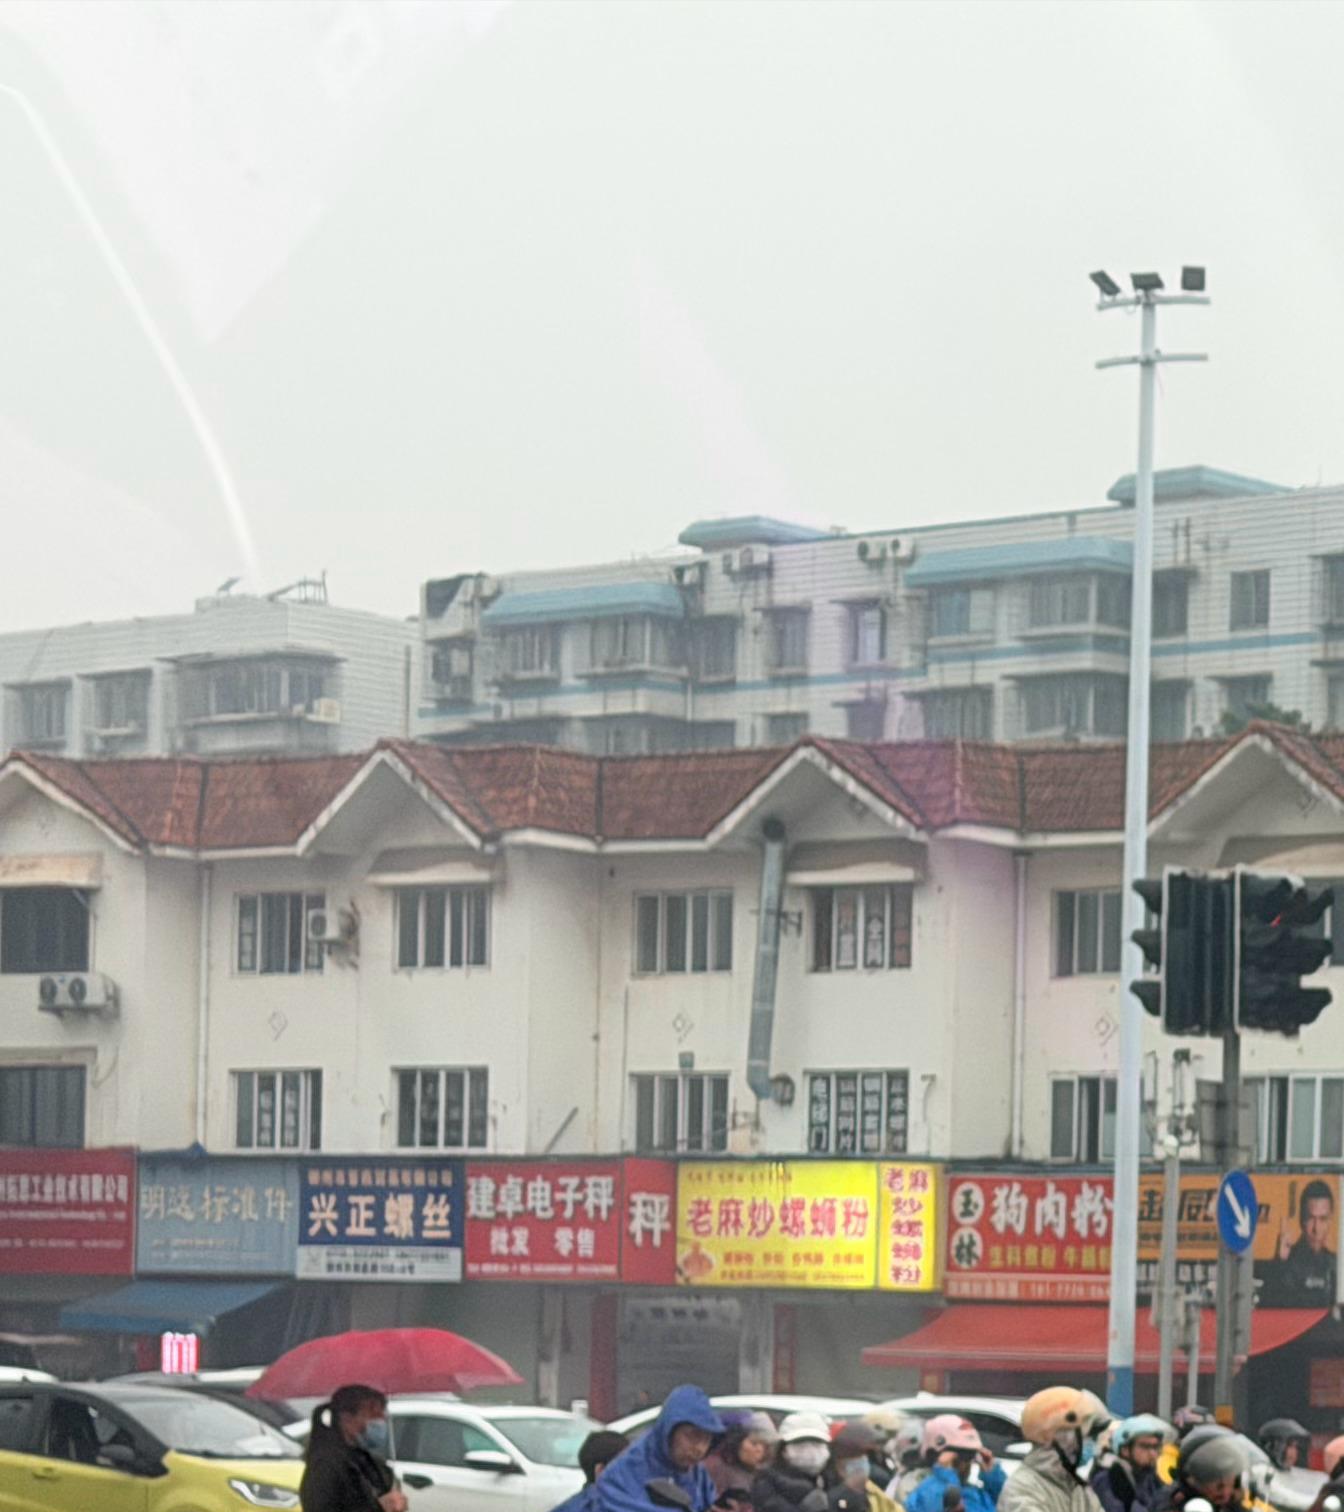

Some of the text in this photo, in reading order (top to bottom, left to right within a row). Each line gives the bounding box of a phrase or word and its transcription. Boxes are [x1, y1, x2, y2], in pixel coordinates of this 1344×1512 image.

[308, 1191, 453, 1240] 兴正螺丝
[466, 1173, 614, 1222] 建卓电子秤
[628, 1191, 671, 1248] 秤
[990, 1180, 1115, 1240] 狗肉粉
[490, 1225, 596, 1259] 批发 零售
[954, 1187, 980, 1267] 玉林
